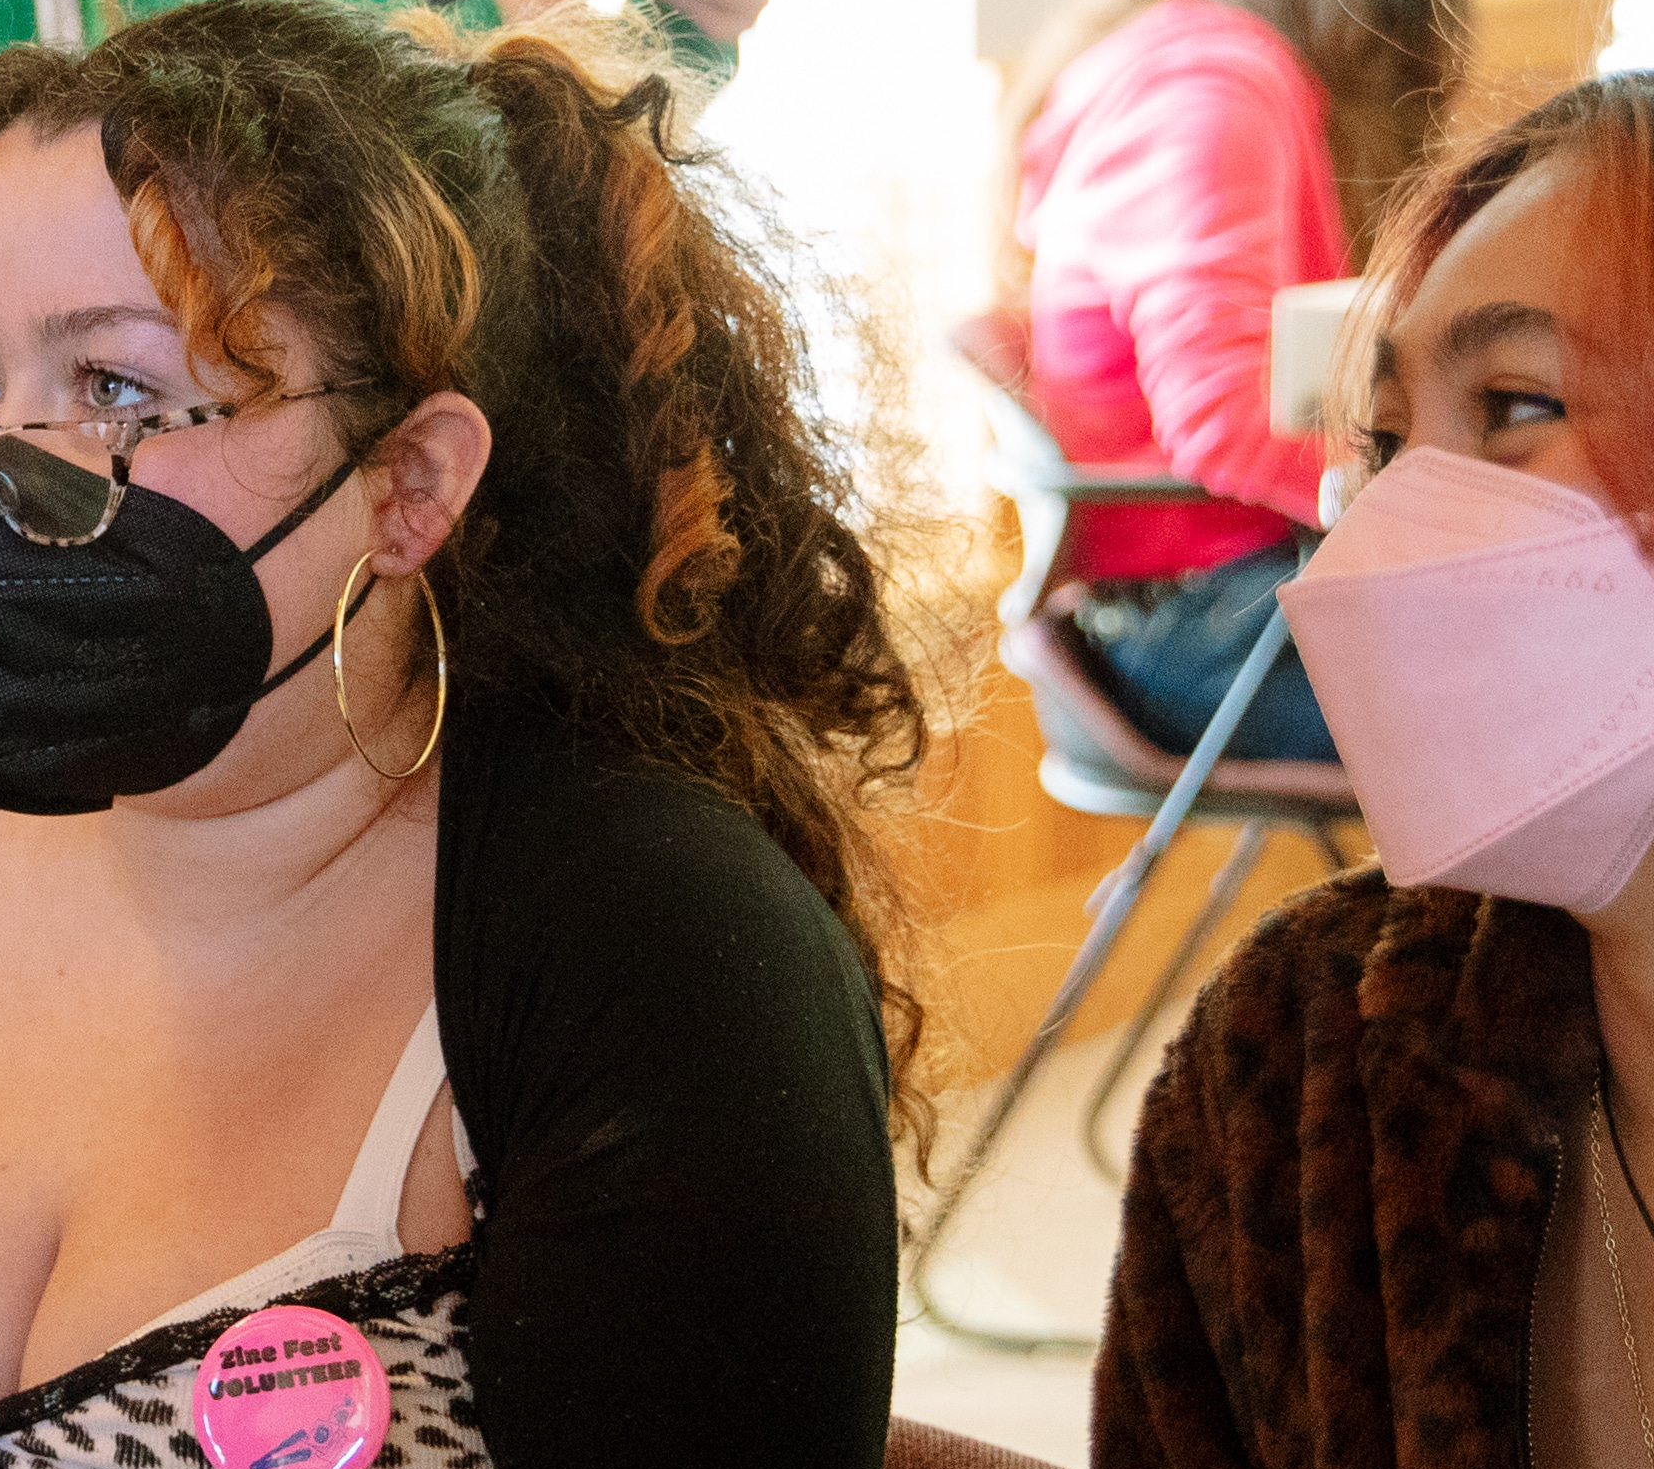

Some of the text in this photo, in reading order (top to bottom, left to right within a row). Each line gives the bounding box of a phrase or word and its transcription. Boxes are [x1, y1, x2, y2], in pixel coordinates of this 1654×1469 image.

[219, 1331, 343, 1370] Zine Fest
[208, 1359, 363, 1401] VOLUNTEER
